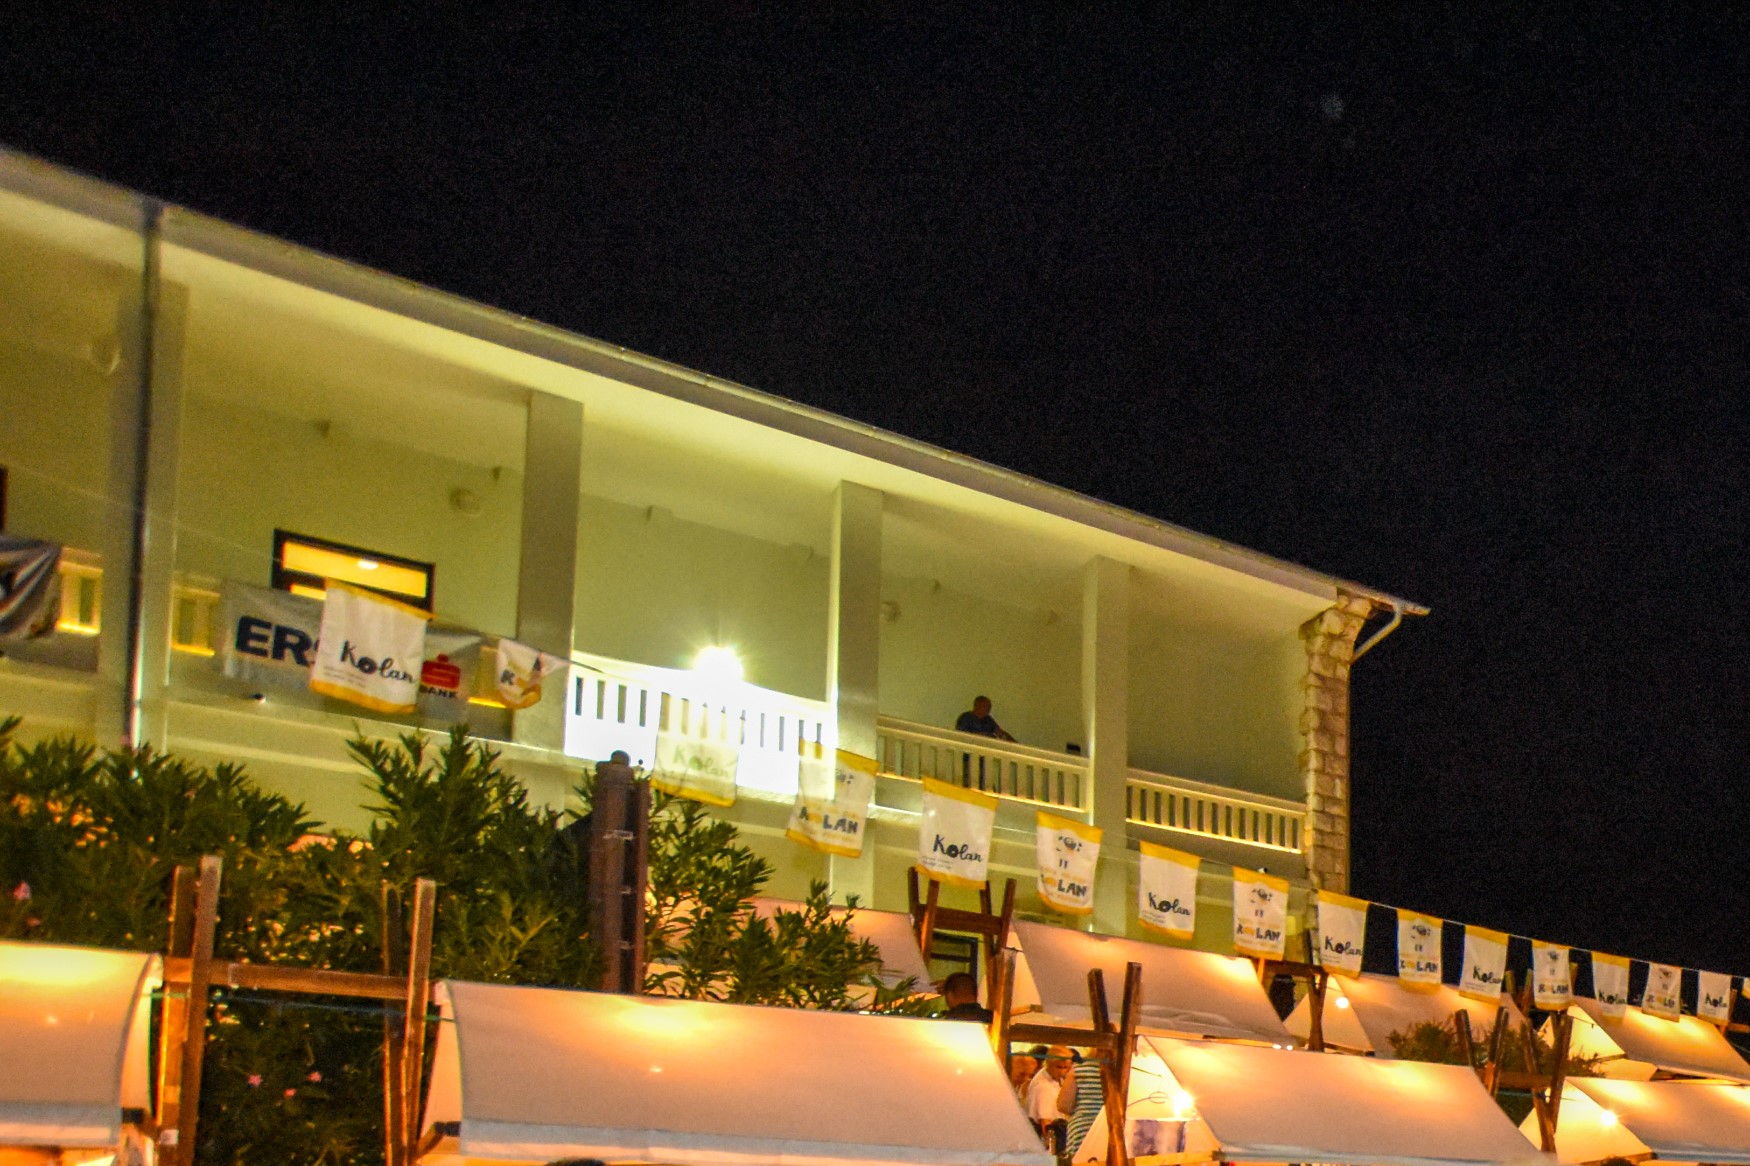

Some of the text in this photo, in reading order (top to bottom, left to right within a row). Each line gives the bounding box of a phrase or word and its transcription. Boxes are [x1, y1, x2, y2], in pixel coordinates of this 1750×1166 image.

[339, 639, 415, 684] Kolan
[932, 833, 983, 863] Kolan
[1148, 891, 1190, 916] Kolan
[1325, 935, 1362, 956] Kolan
